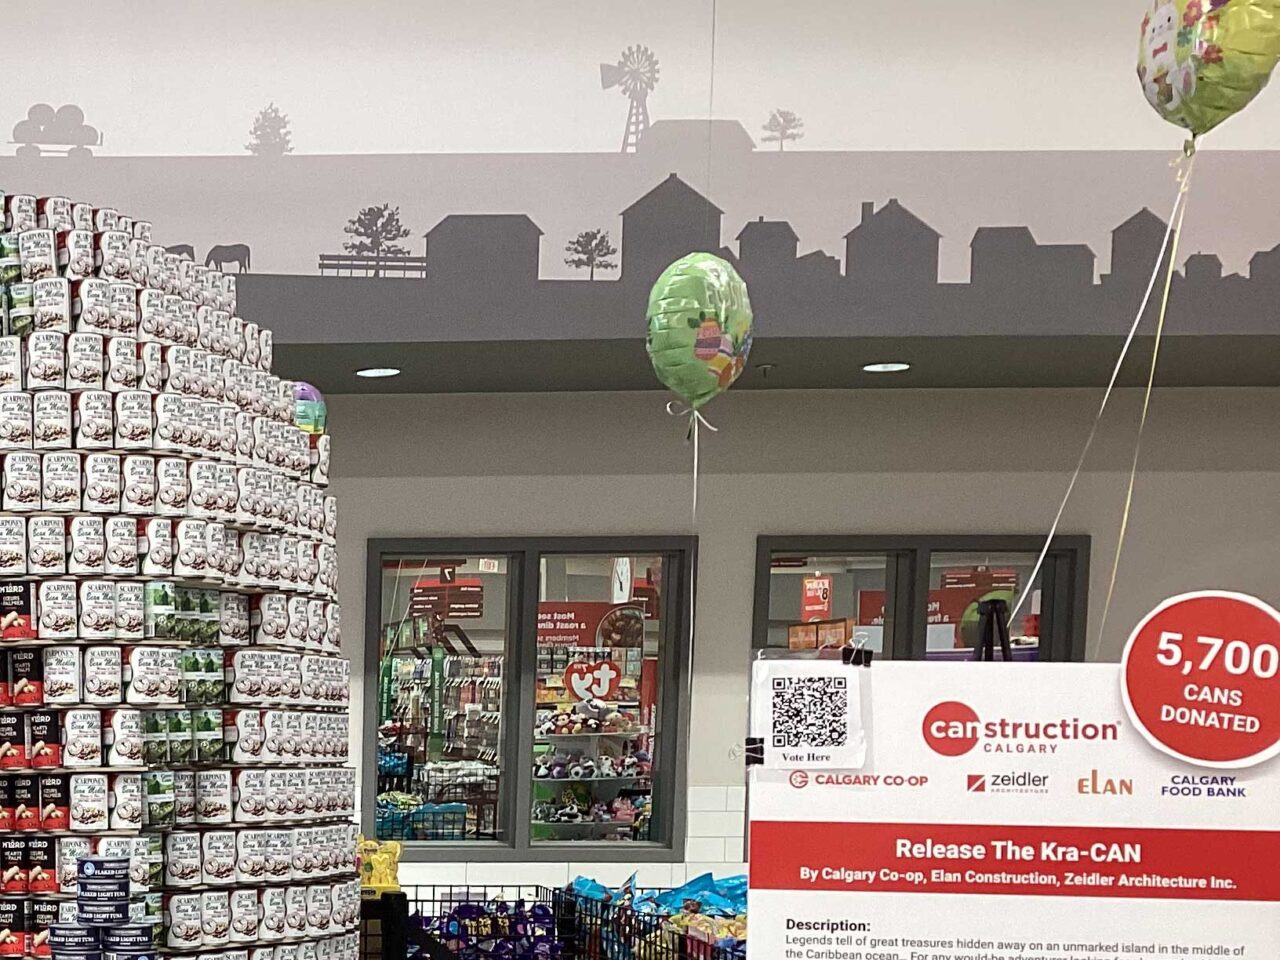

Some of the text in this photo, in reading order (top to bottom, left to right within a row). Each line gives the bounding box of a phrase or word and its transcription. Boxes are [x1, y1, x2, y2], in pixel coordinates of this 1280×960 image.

[1156, 631, 1280, 679] 5,700
[1183, 684, 1243, 706] CANS
[1160, 704, 1261, 733] DONATED
[930, 718, 1118, 740] canstruction
[983, 743, 1058, 754] CALGARY
[782, 753, 830, 762] Vote Here
[815, 774, 880, 786] CALGARY
[991, 771, 1049, 787] zeidler
[1171, 775, 1237, 786] CALGARY
[1161, 786, 1246, 797] FOOD BANK
[896, 838, 1142, 863] Release The Kra-CAN
[800, 867, 1237, 889] By Calgary Co-op, Elan Construction, Zeidler Architecture Inc.
[785, 919, 871, 932] Description:
[785, 935, 1245, 956] Legends tell of great treasures hidden away on an unmarked island in the middle of
[785, 948, 804, 958] the
[805, 949, 862, 960] Caribbean
